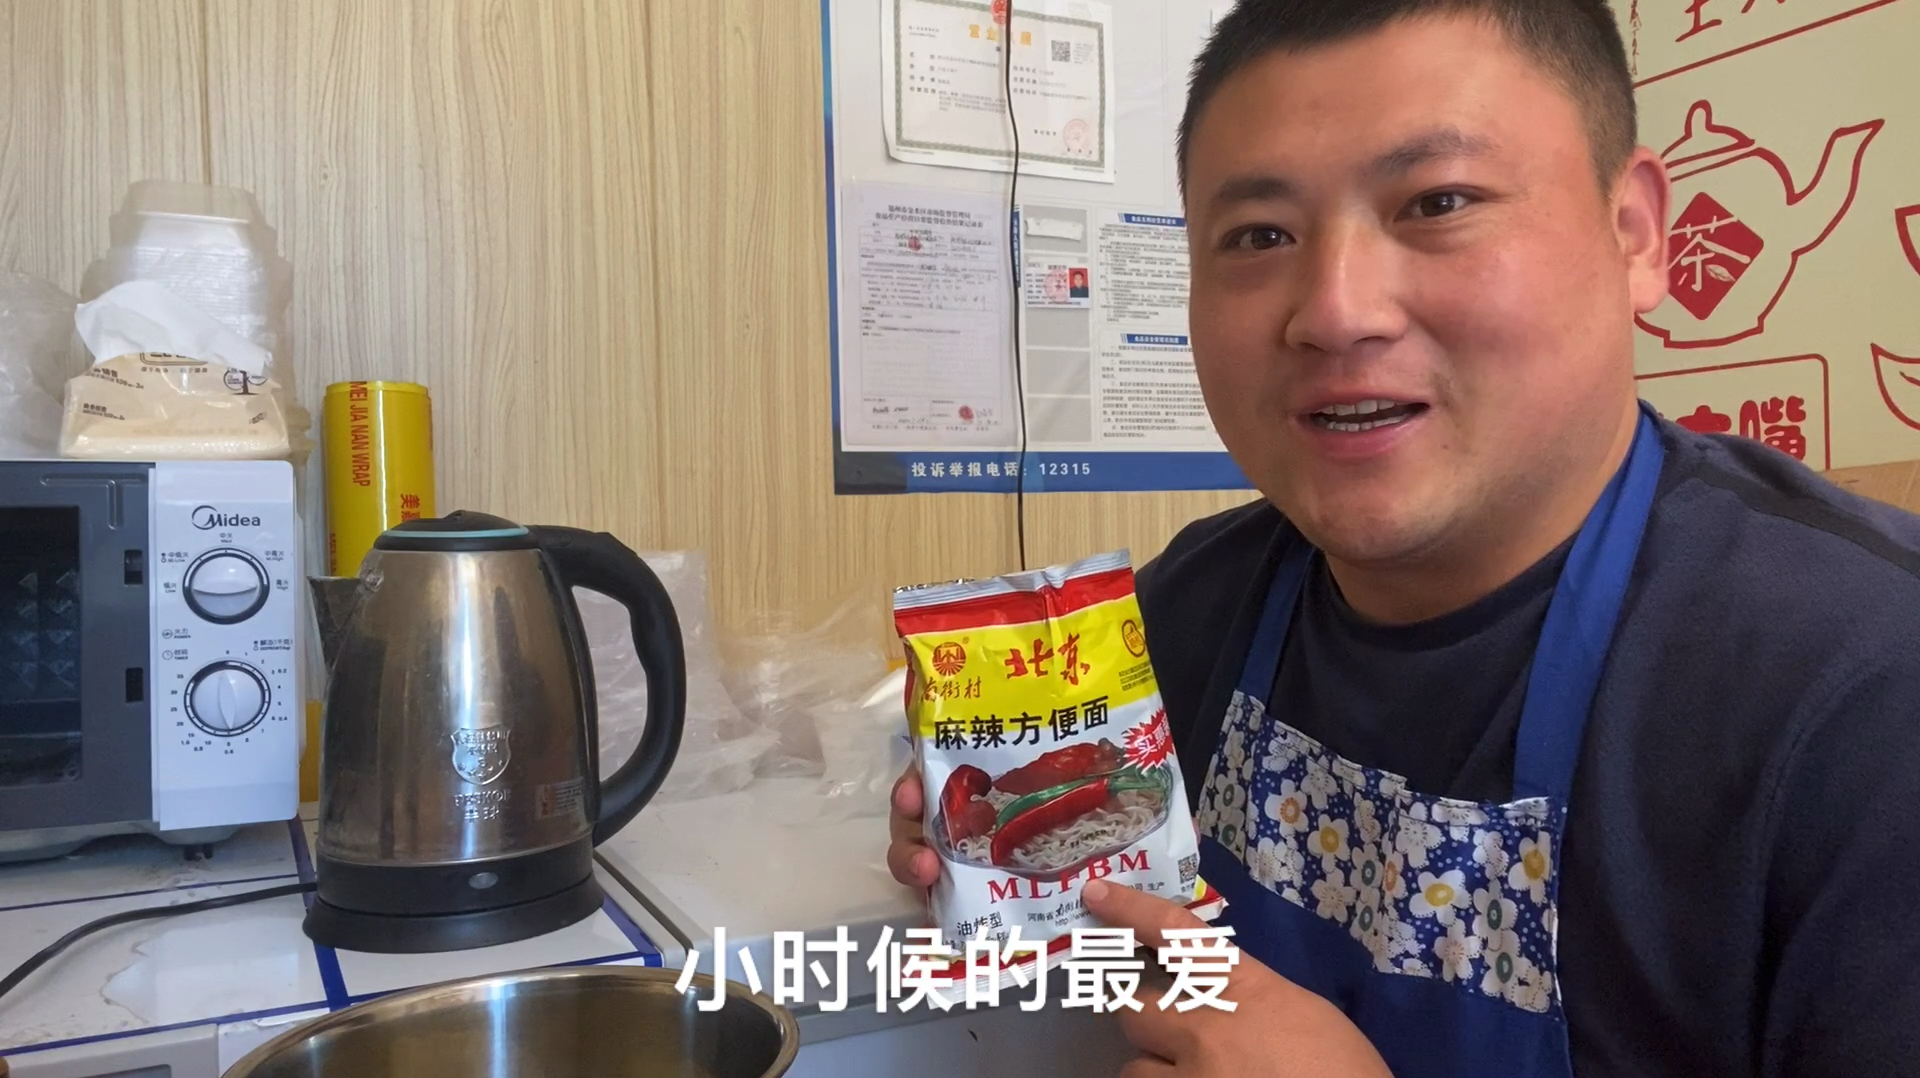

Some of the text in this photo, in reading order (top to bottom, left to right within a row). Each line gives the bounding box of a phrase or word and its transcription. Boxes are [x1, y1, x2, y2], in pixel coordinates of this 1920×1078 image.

[1668, 215, 1751, 292] 茶
[350, 381, 370, 487] MEI JIA NAN WRAP
[1039, 462, 1091, 476] 12315
[191, 505, 261, 531] Midea
[1004, 632, 1091, 686] 北京
[934, 695, 1109, 750] 麻辣方便面
[987, 850, 1151, 904] MLFBM
